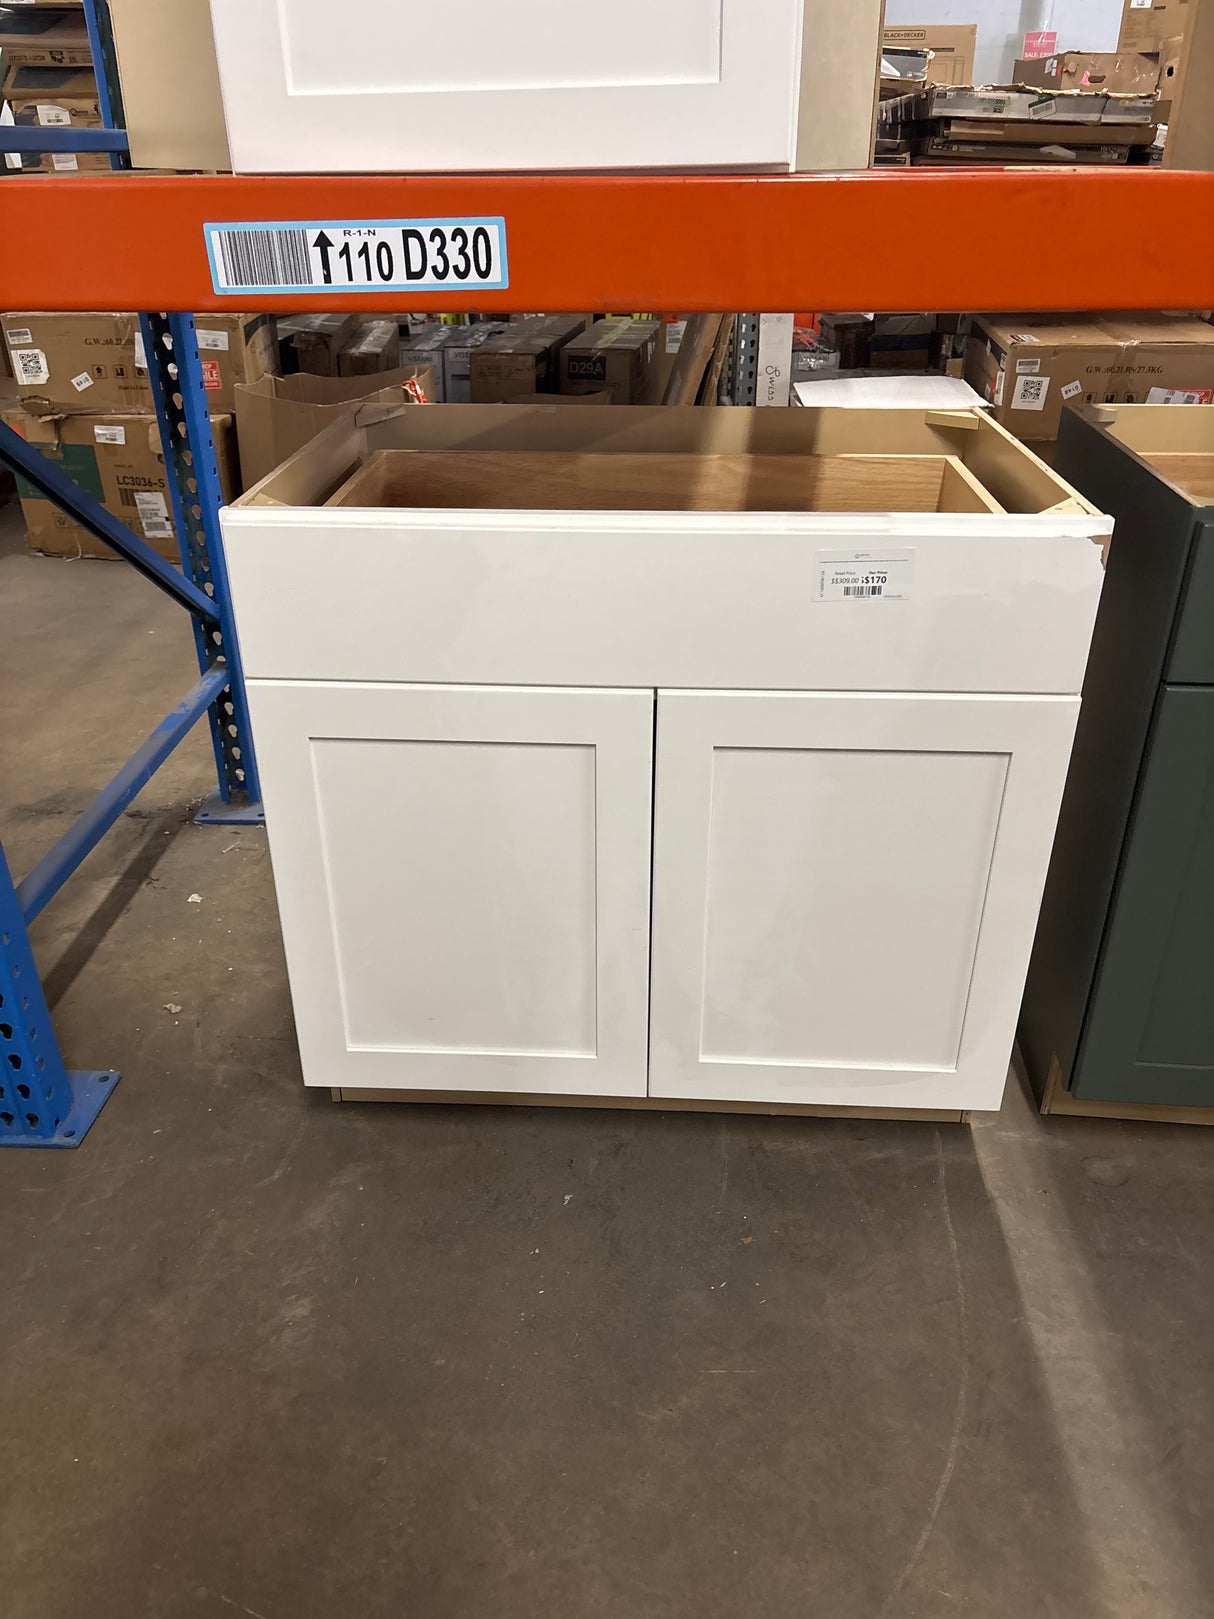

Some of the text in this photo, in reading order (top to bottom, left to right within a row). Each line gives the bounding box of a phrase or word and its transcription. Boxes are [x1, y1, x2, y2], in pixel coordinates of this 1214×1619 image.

[343, 229, 377, 237] R-1-N
[338, 226, 493, 282] 110 D330
[569, 361, 604, 374] D29A
[115, 475, 166, 488] LC3036-S
